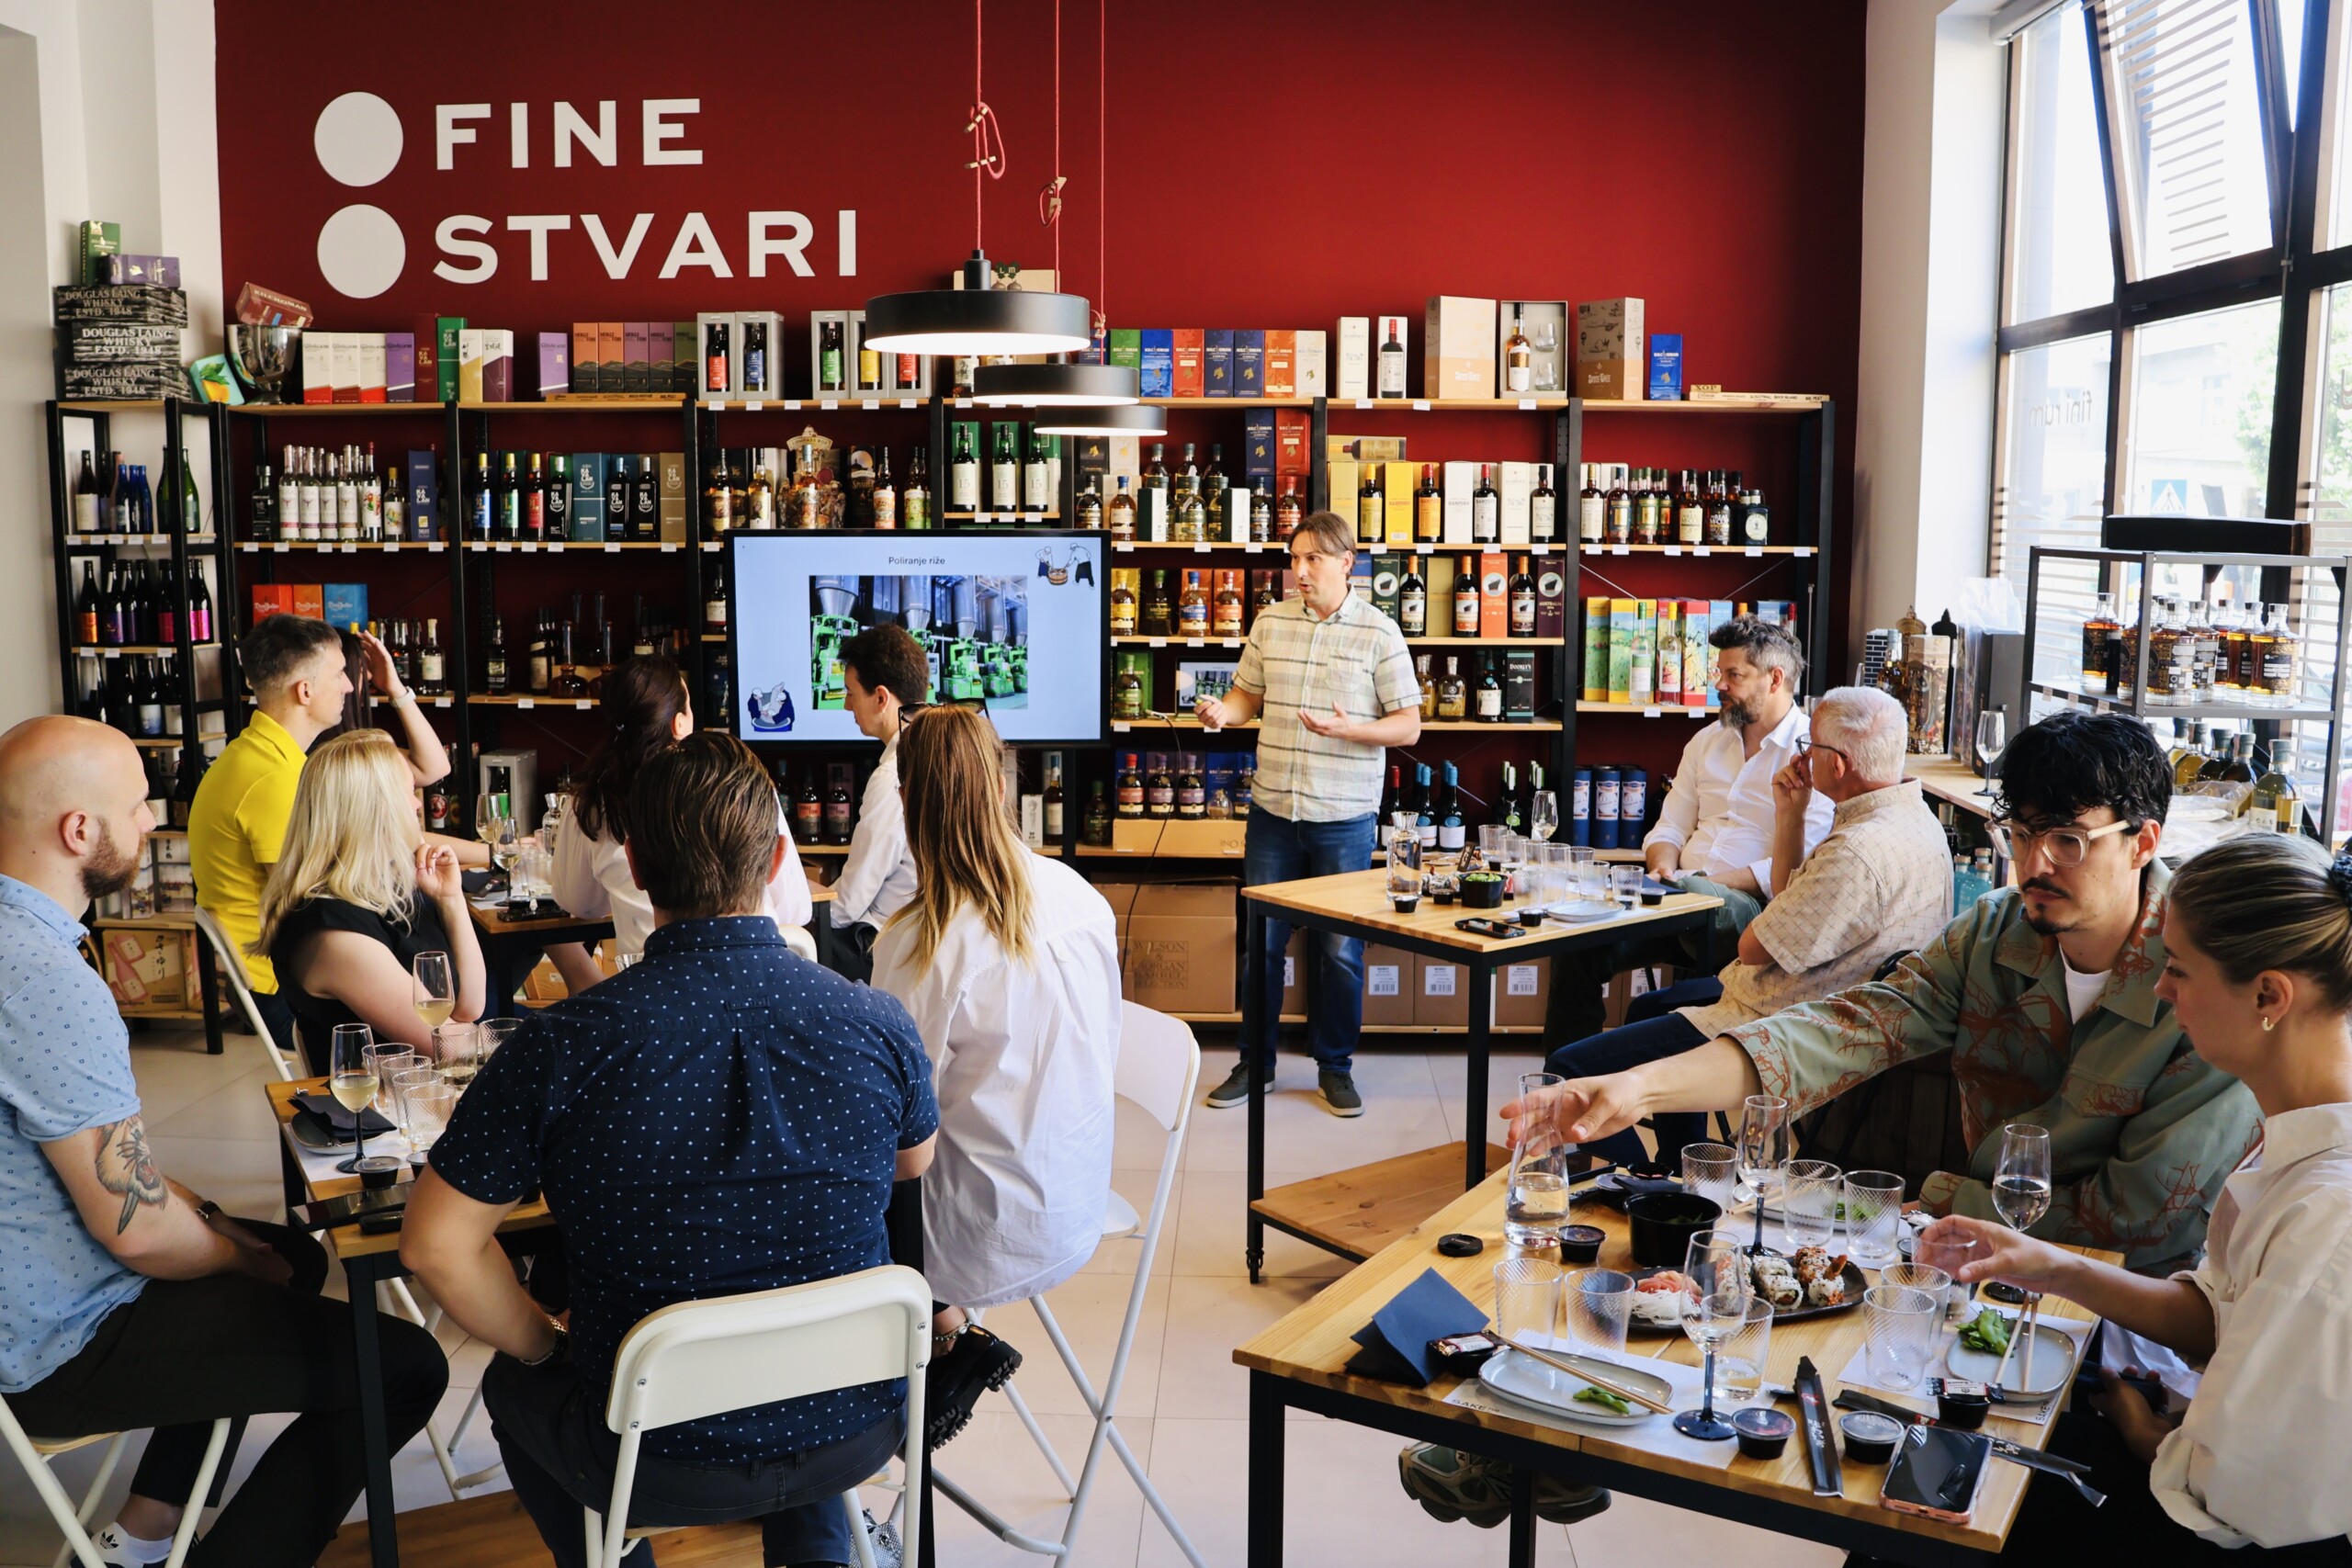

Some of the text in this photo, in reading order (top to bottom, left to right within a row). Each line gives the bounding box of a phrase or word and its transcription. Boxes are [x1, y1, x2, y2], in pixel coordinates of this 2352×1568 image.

[435, 98, 703, 170] FINE
[433, 209, 856, 284] STVARI
[65, 289, 140, 300] DOUGLAS LAING
[84, 299, 123, 307] WHISKY
[254, 288, 308, 312] KILCHOMAN
[82, 328, 172, 339] DOUGLAS LAING
[104, 337, 152, 346] WHISKY
[134, 346, 162, 355] 1948
[74, 368, 154, 378] DOUGLAS LAING
[92, 378, 137, 386] WHISKY
[959, 479, 970, 489] 15
[998, 479, 1009, 490] 15
[1031, 479, 1042, 489] 15
[888, 556, 945, 566] Poliranje riže
[1453, 1398, 1487, 1411] SAKE
